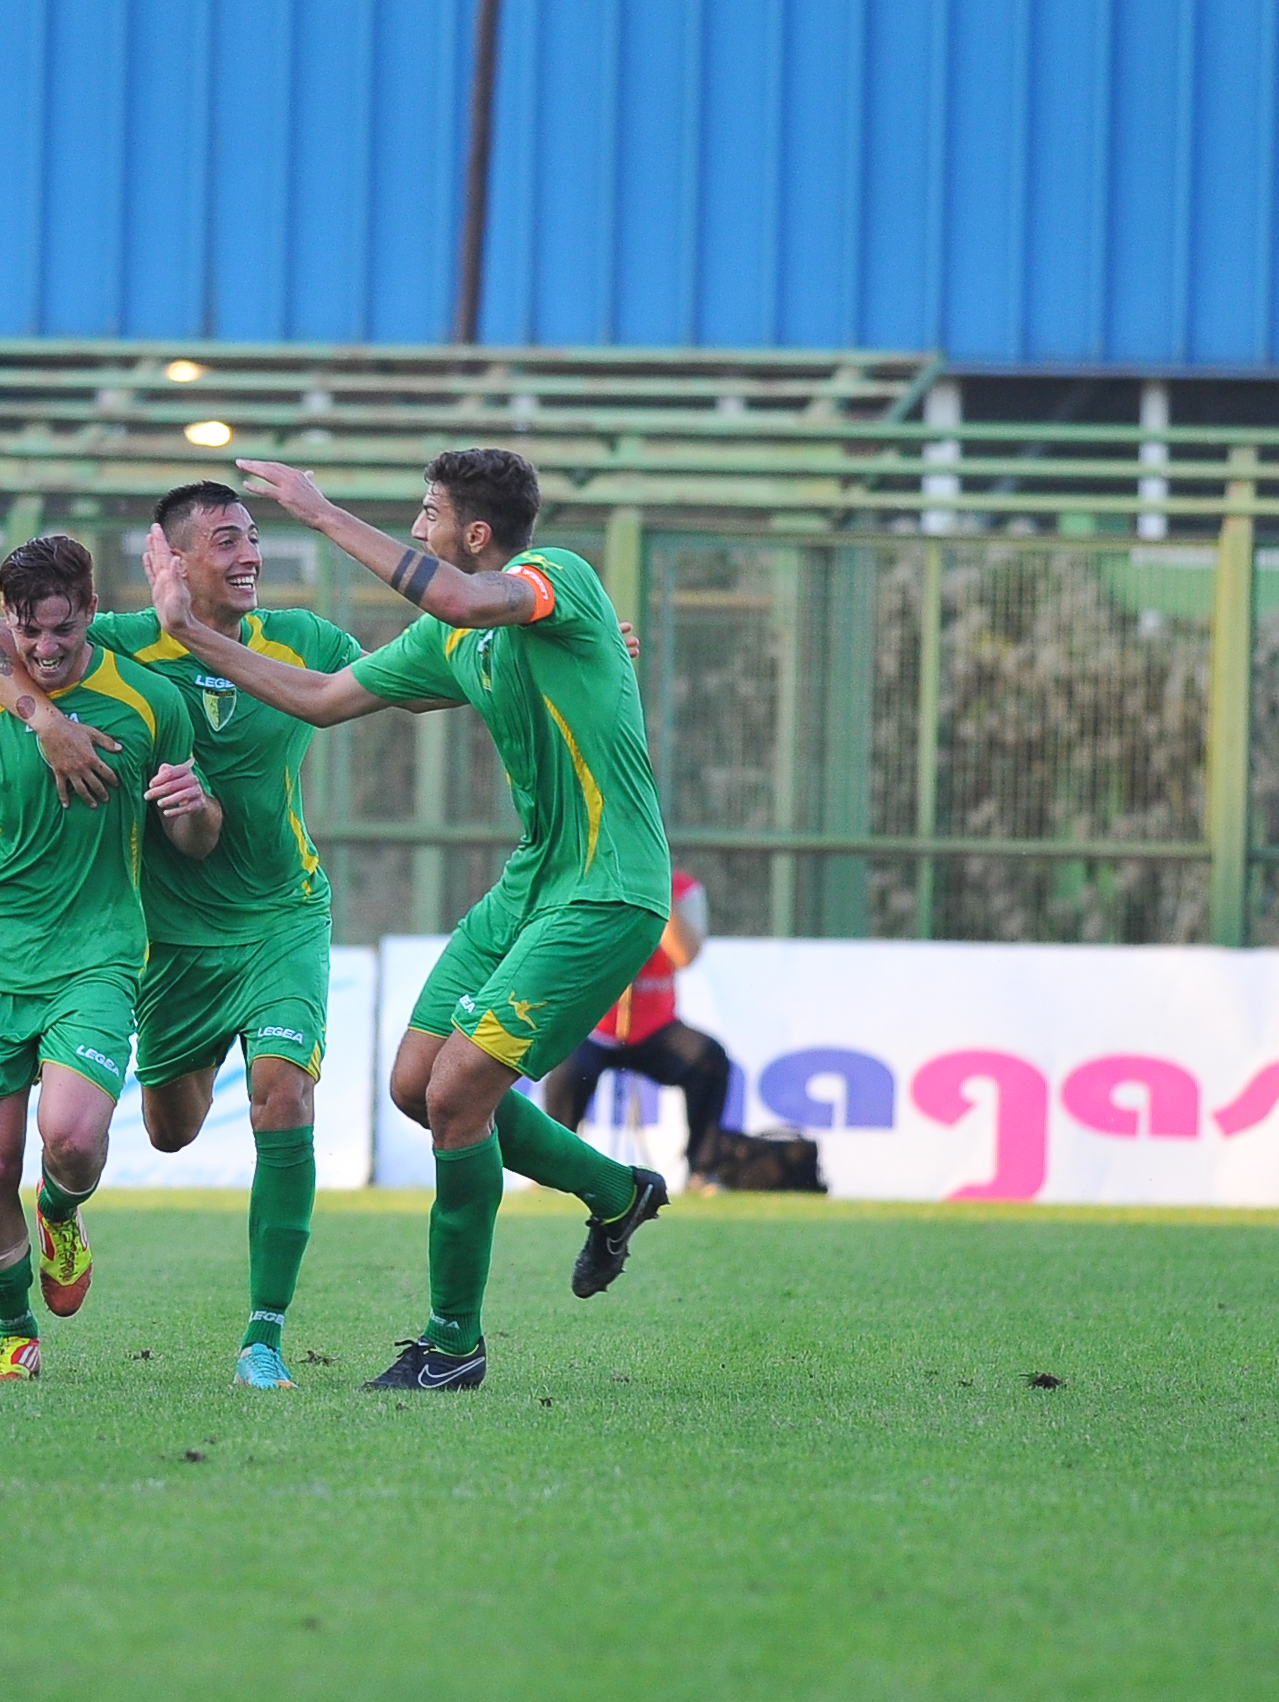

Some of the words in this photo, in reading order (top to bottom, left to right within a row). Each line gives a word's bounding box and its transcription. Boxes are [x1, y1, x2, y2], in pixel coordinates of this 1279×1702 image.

[195, 674, 236, 689] LEGE
[257, 1025, 303, 1044] LEGEA
[76, 1044, 119, 1077] LEGEA
[248, 1309, 285, 1326] LEGE
